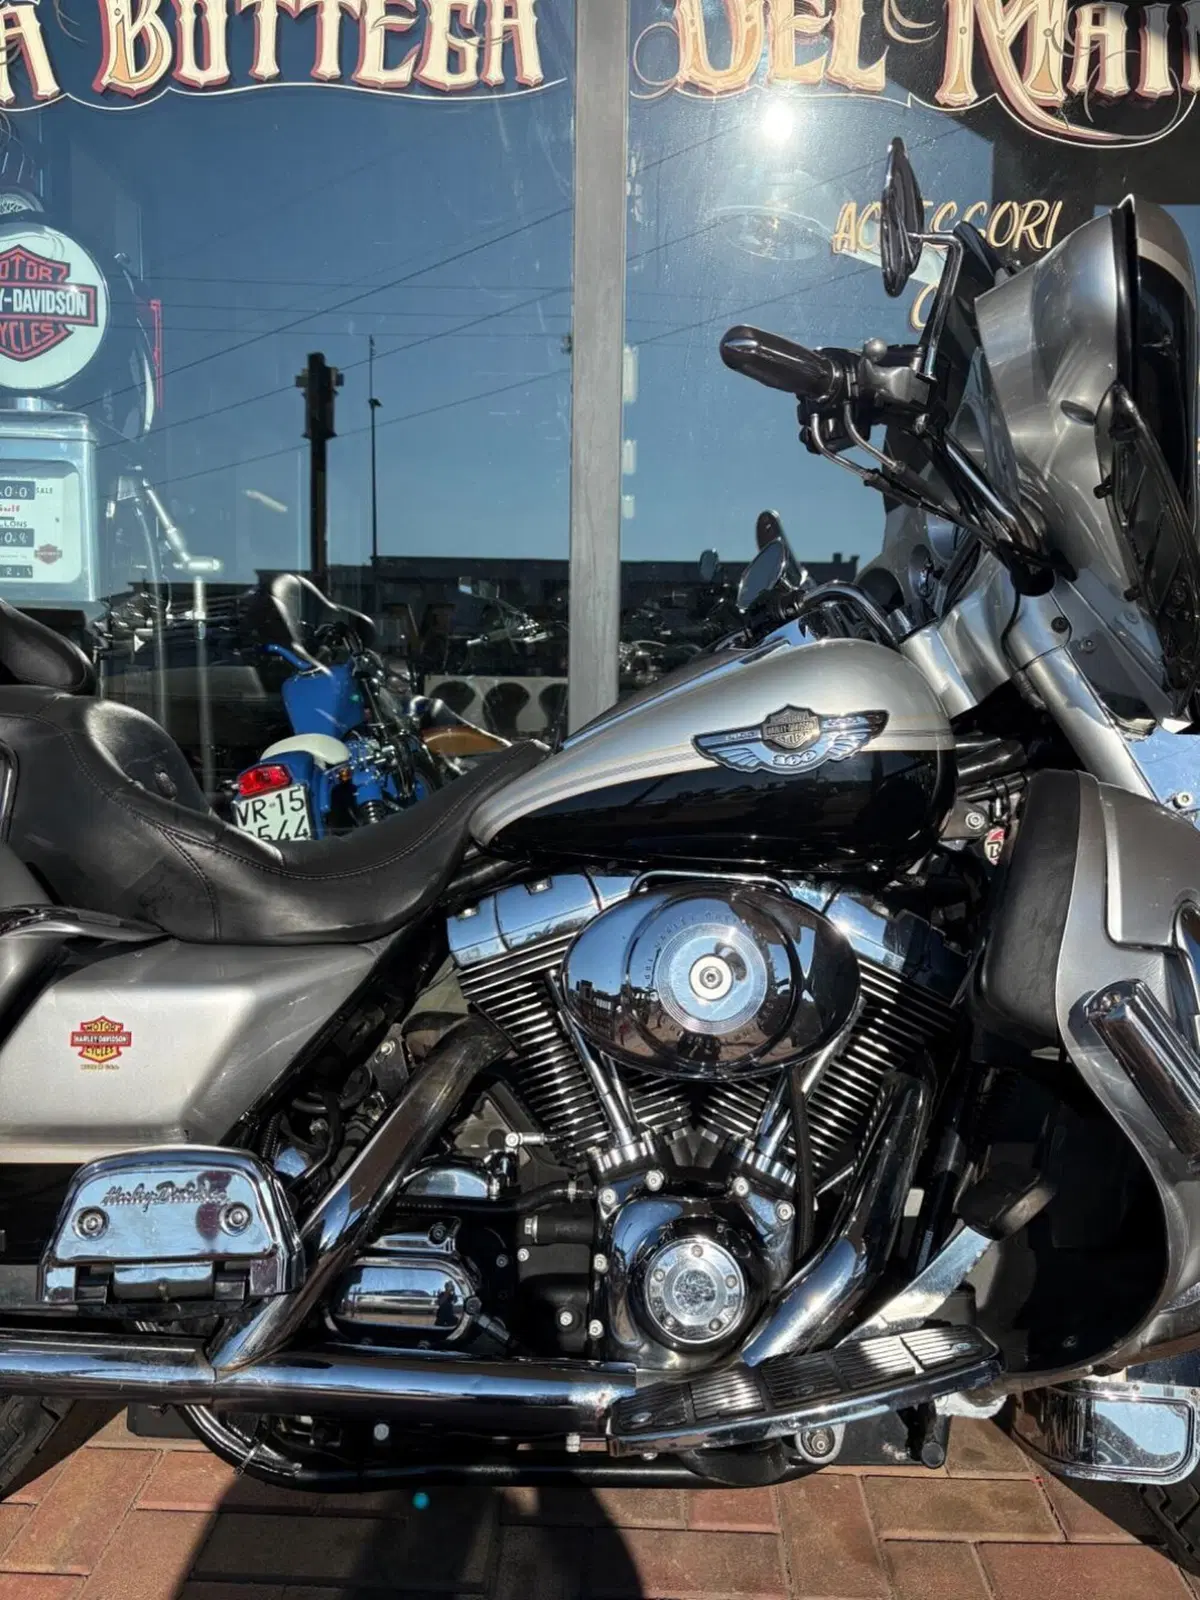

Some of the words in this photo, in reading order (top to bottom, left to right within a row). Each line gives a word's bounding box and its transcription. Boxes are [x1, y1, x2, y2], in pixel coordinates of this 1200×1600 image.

[247, 815, 309, 841] 544
[86, 1021, 116, 1031] MOTOR
[86, 1046, 114, 1057] CYCLES
